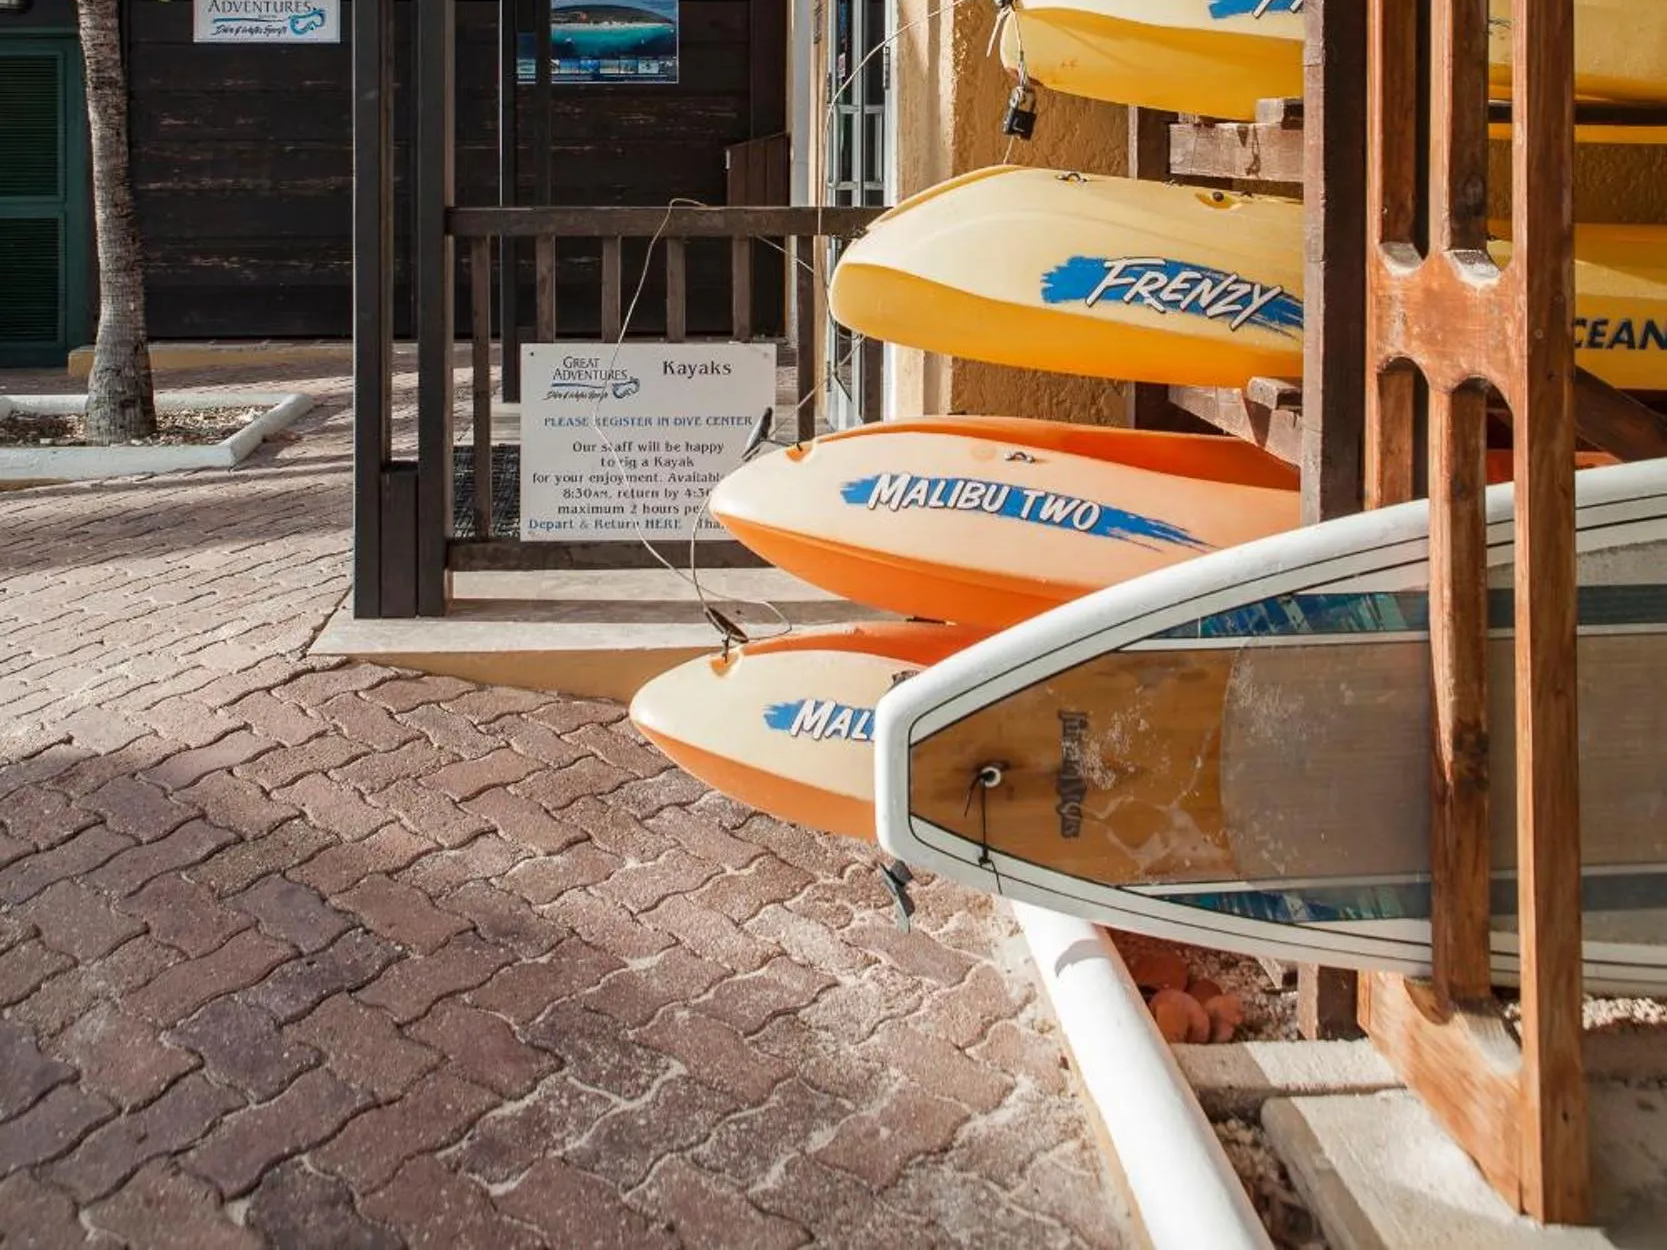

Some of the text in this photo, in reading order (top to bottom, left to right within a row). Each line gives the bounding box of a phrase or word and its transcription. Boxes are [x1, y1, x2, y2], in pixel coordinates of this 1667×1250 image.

[208, 0, 312, 13] ADVENTURES
[1085, 256, 1283, 332] FRENZY
[1573, 317, 1667, 350] CEAN
[562, 356, 600, 369] GREAT
[552, 368, 628, 380] ADVENTURES
[662, 360, 733, 380] Kayaks
[544, 417, 589, 427] PLEASE
[657, 416, 669, 426] IN
[673, 416, 701, 426] DIVE
[706, 416, 753, 426] CENTER
[572, 441, 596, 452] Our
[638, 440, 660, 452] will
[664, 440, 681, 452] be
[684, 441, 725, 454] happy
[601, 458, 616, 468] to
[641, 459, 649, 468] a
[654, 456, 695, 468] Kayak
[532, 472, 549, 484] for
[555, 474, 583, 486] your
[617, 488, 660, 499] return
[664, 487, 679, 500] by
[557, 503, 704, 517] maximum 2 hours pe
[868, 474, 1100, 532] MALIBU TWO
[528, 519, 573, 532] Depart
[594, 519, 639, 529] Return
[696, 519, 725, 529] Tha
[790, 699, 876, 742] MAL
